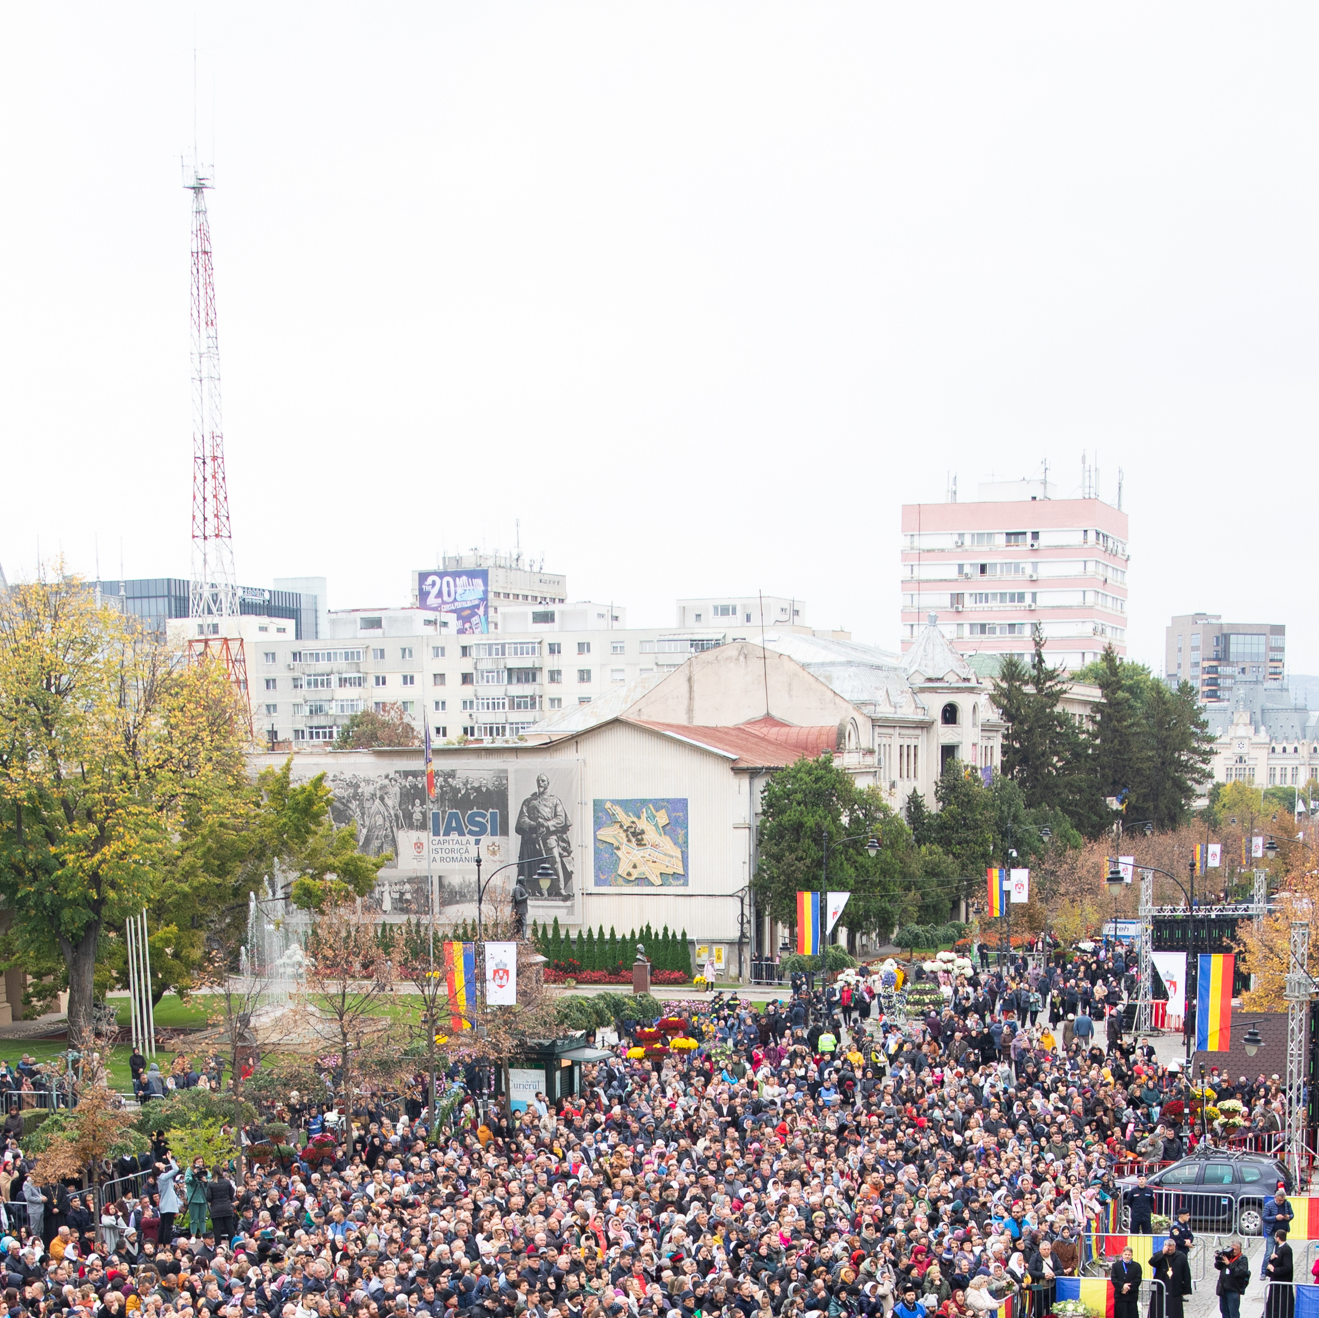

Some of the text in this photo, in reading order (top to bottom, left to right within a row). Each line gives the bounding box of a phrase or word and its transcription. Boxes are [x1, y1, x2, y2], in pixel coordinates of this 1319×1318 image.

[426, 574, 455, 606] 20
[431, 846, 470, 855] ISTORICĂ
[439, 855, 480, 863] ROMÂNIE
